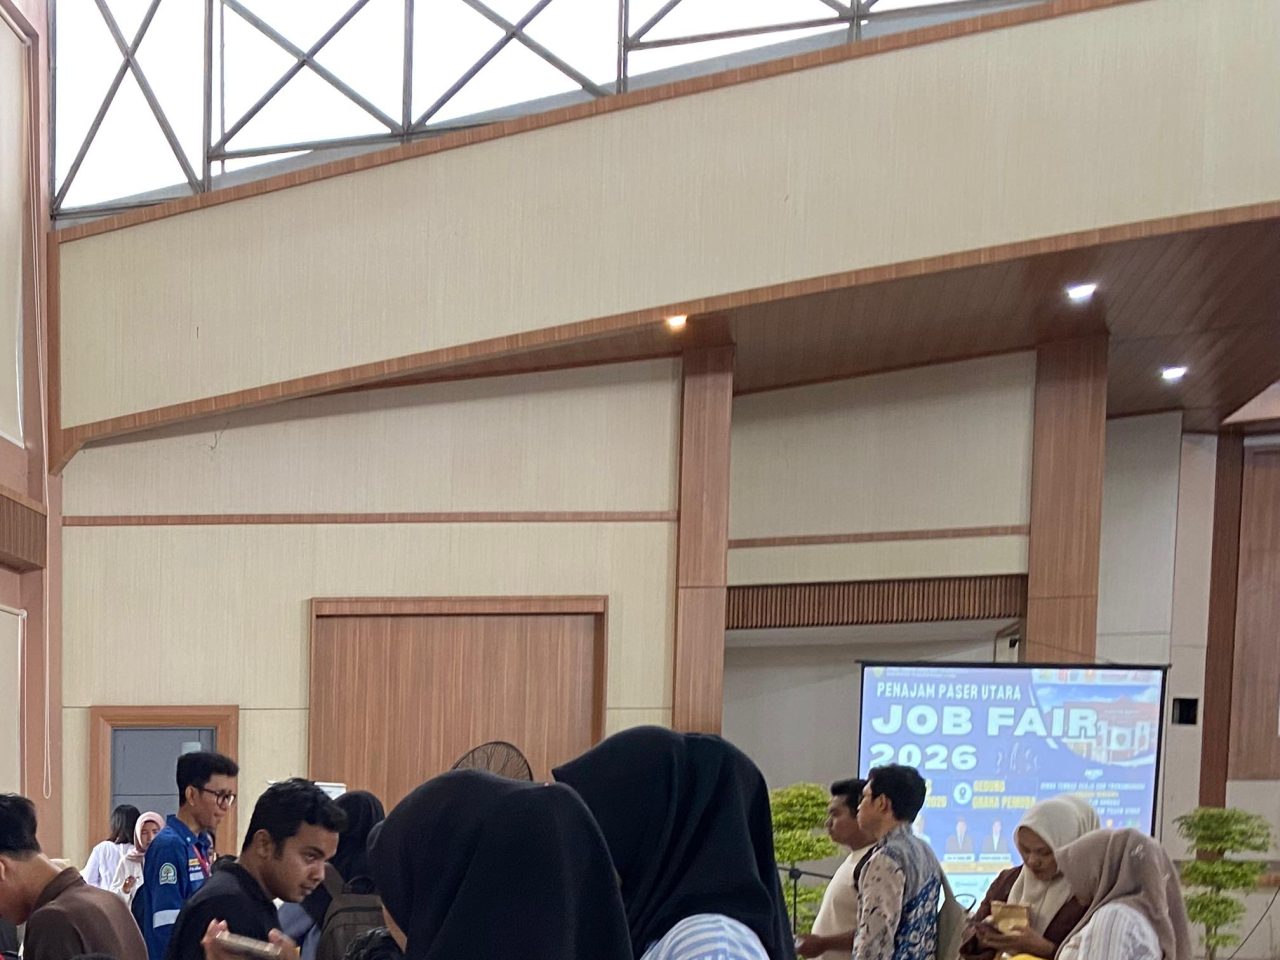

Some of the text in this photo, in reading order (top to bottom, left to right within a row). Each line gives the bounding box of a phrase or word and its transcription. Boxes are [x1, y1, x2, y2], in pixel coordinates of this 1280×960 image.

[877, 682, 1021, 700] PENAJAM PASER UTARA
[872, 704, 1098, 738] JOB FAIR
[870, 744, 977, 770] 2026
